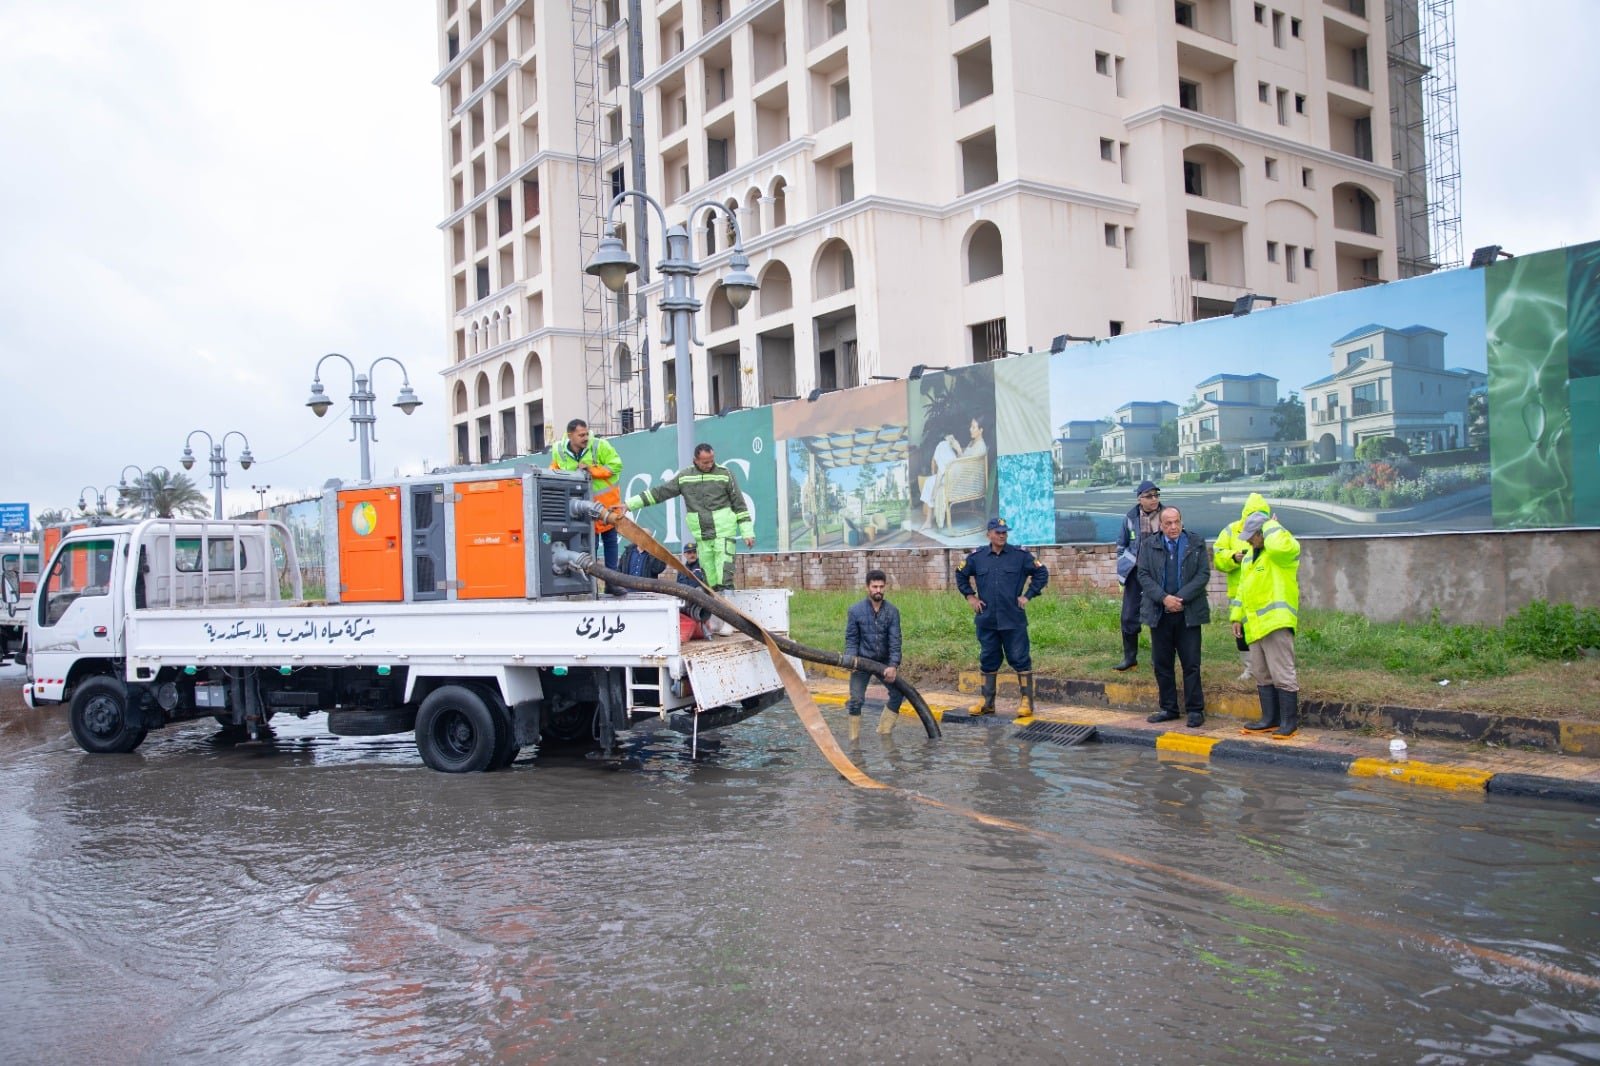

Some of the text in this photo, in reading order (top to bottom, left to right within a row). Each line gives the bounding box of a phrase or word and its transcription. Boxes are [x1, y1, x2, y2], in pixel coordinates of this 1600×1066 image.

[276, 619, 317, 643] الشرب
[321, 620, 343, 643] مياه
[343, 617, 375, 642] شركة
